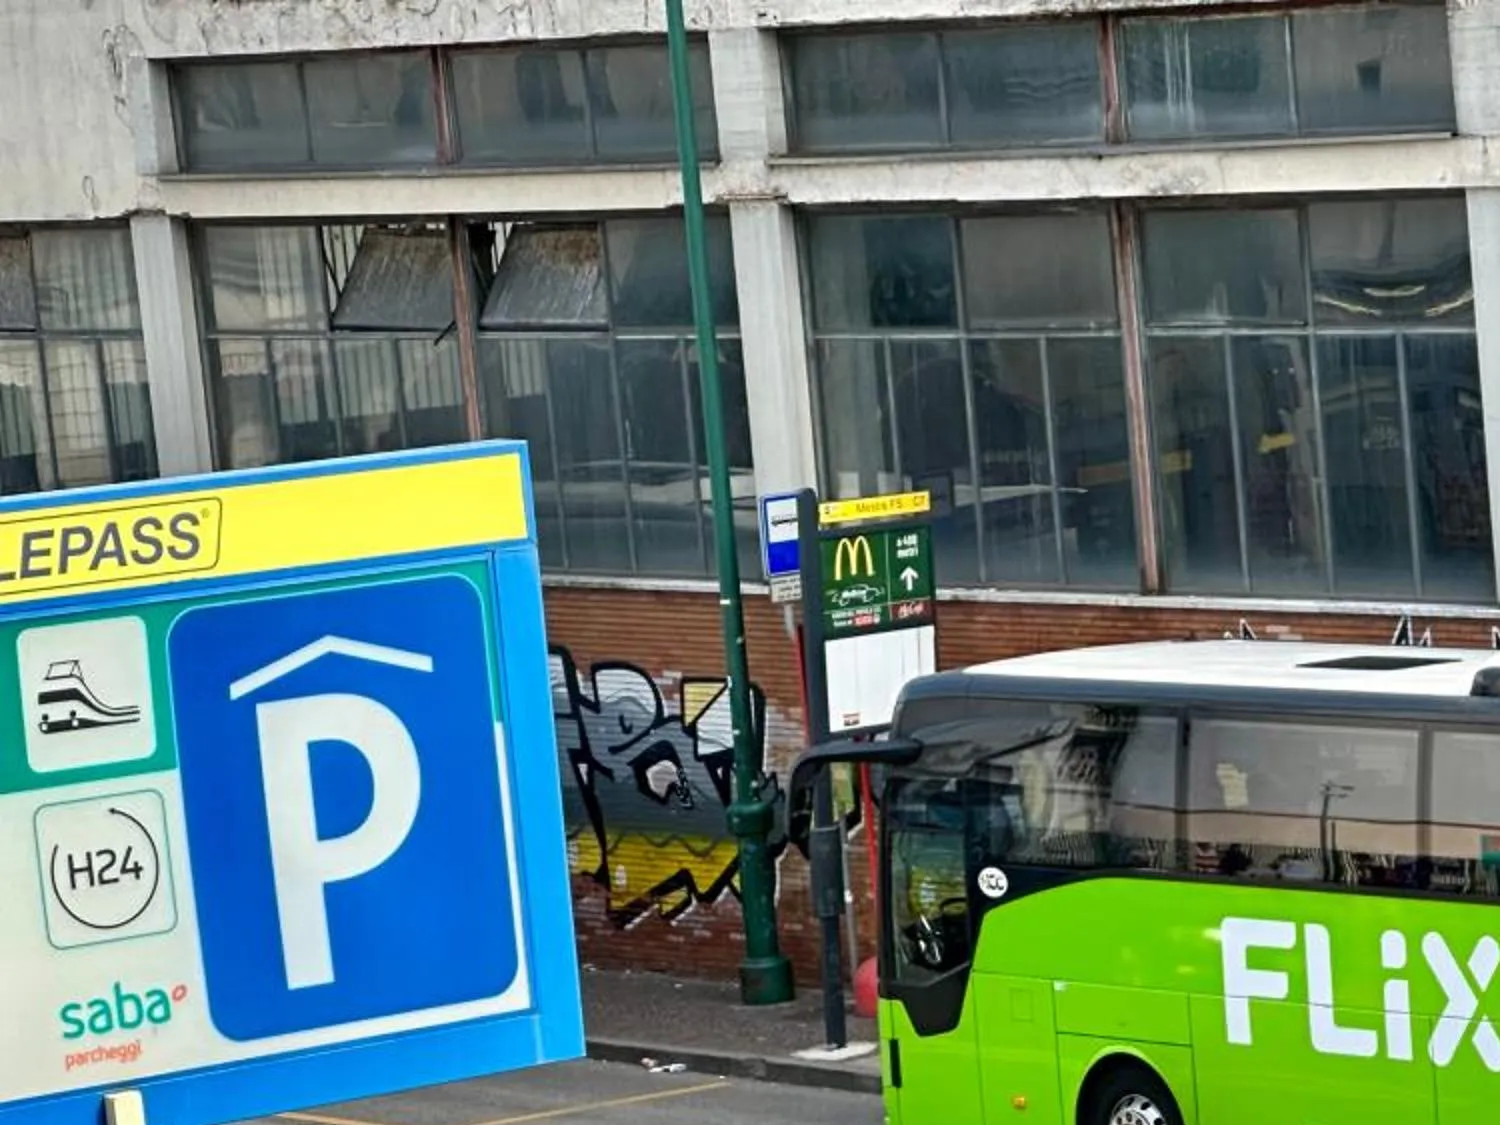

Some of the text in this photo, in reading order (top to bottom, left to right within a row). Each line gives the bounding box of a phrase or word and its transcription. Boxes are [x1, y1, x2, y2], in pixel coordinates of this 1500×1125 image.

[256, 692, 422, 990] P
[67, 846, 143, 890] H24
[65, 1040, 142, 1071] parcheggi
